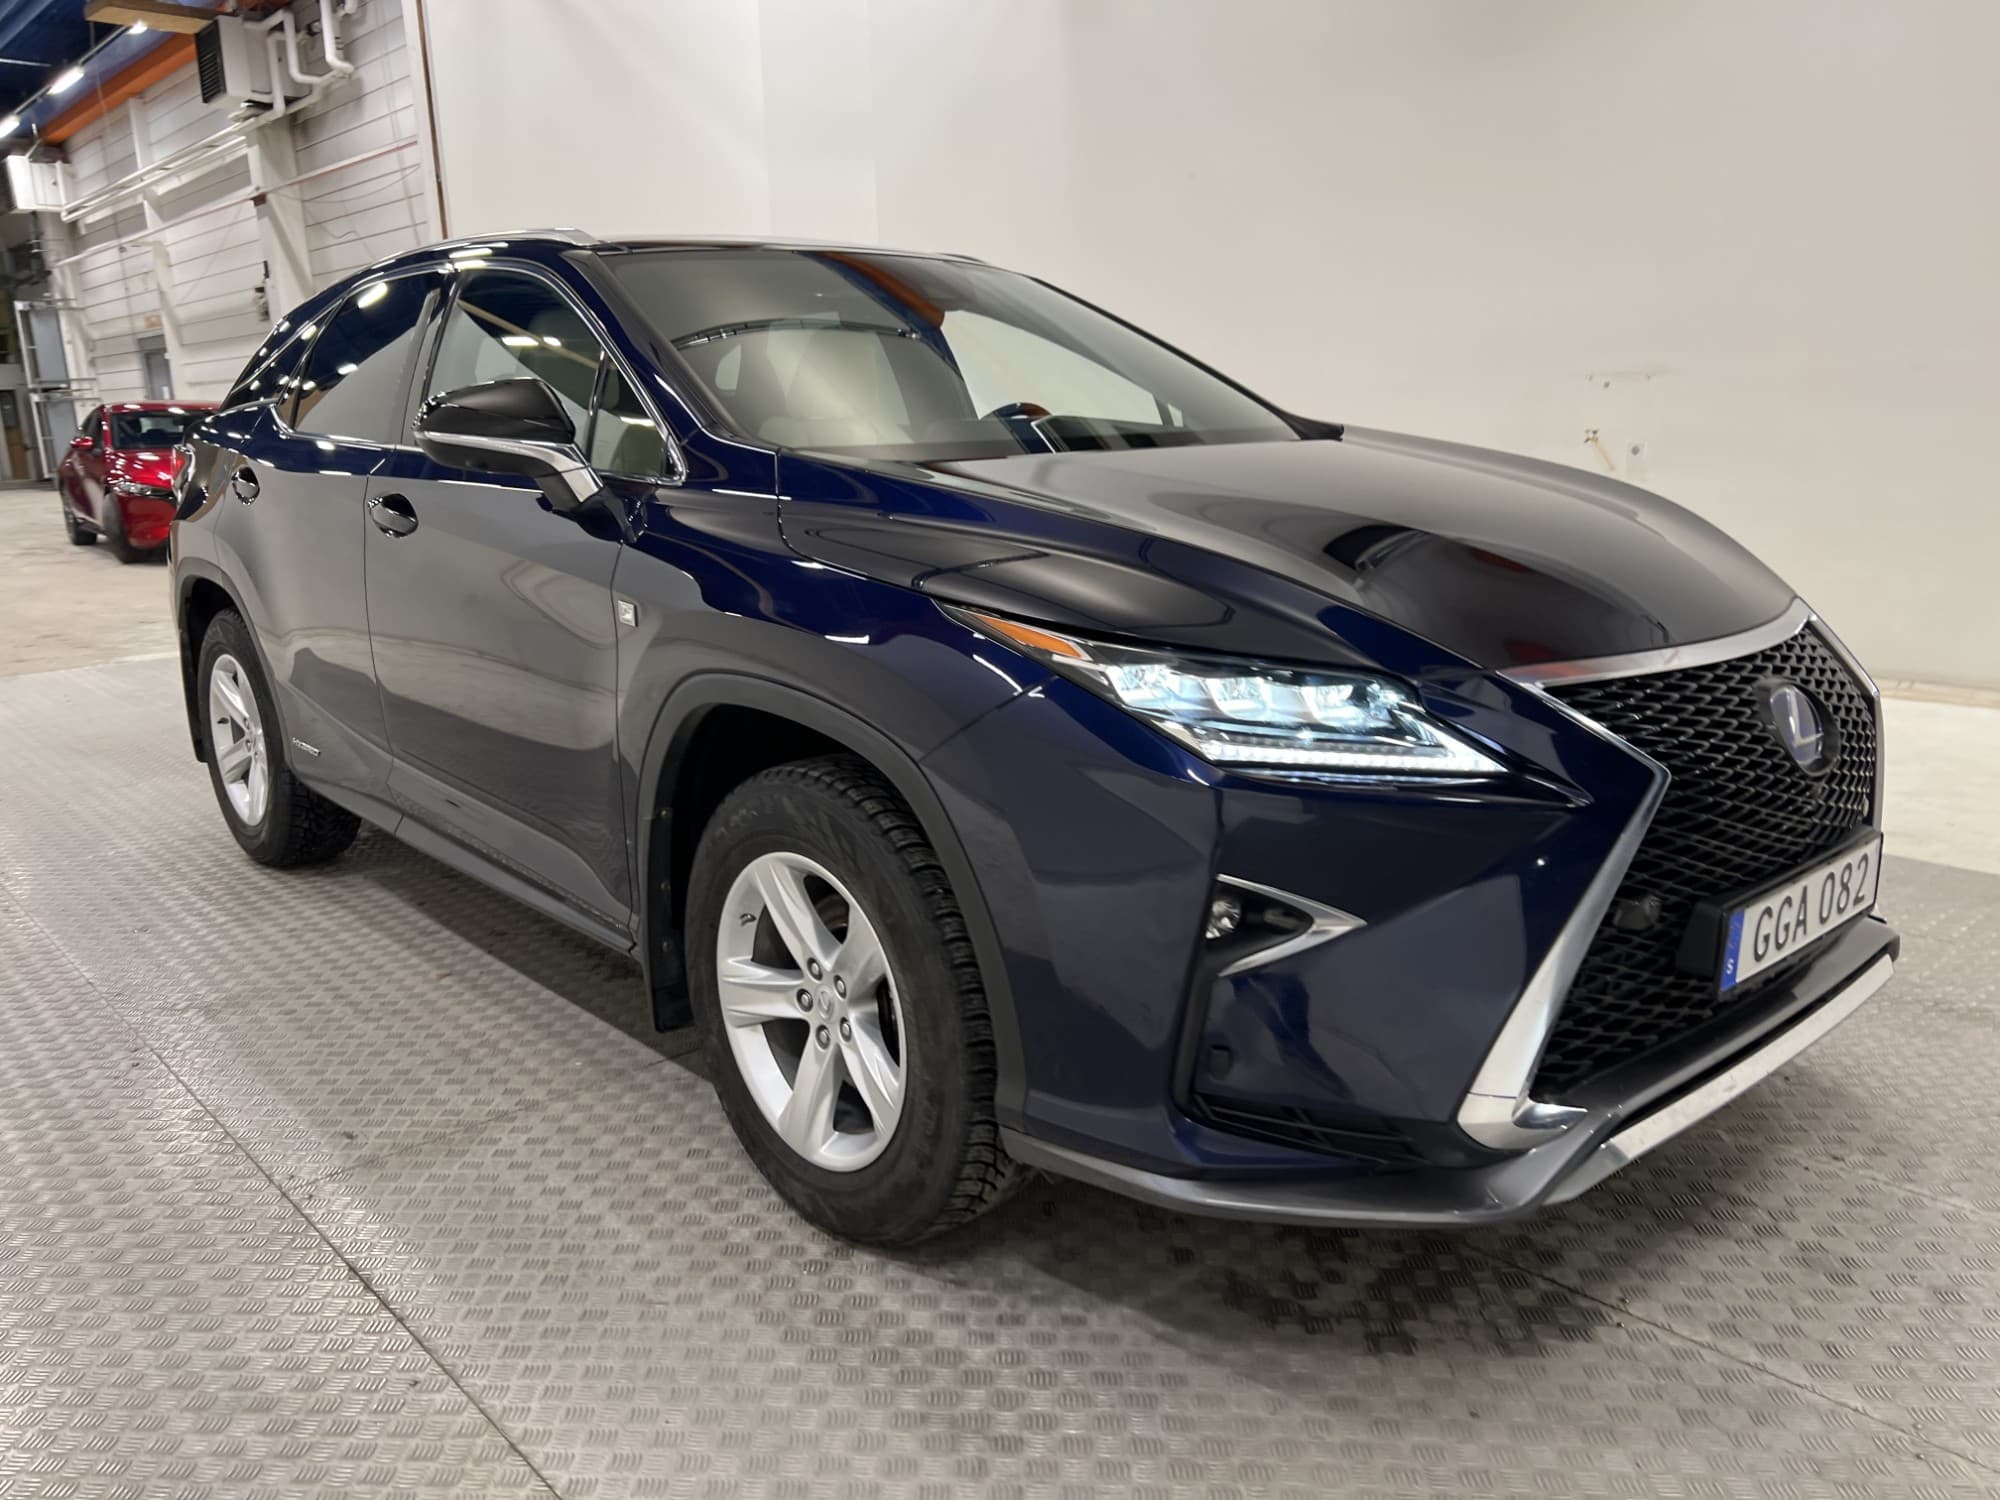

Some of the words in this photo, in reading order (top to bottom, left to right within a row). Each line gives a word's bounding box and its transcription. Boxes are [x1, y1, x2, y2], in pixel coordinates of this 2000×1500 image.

[1754, 885, 1808, 962] GGA
[1819, 853, 1869, 925] 082
[1726, 958, 1734, 974] S
